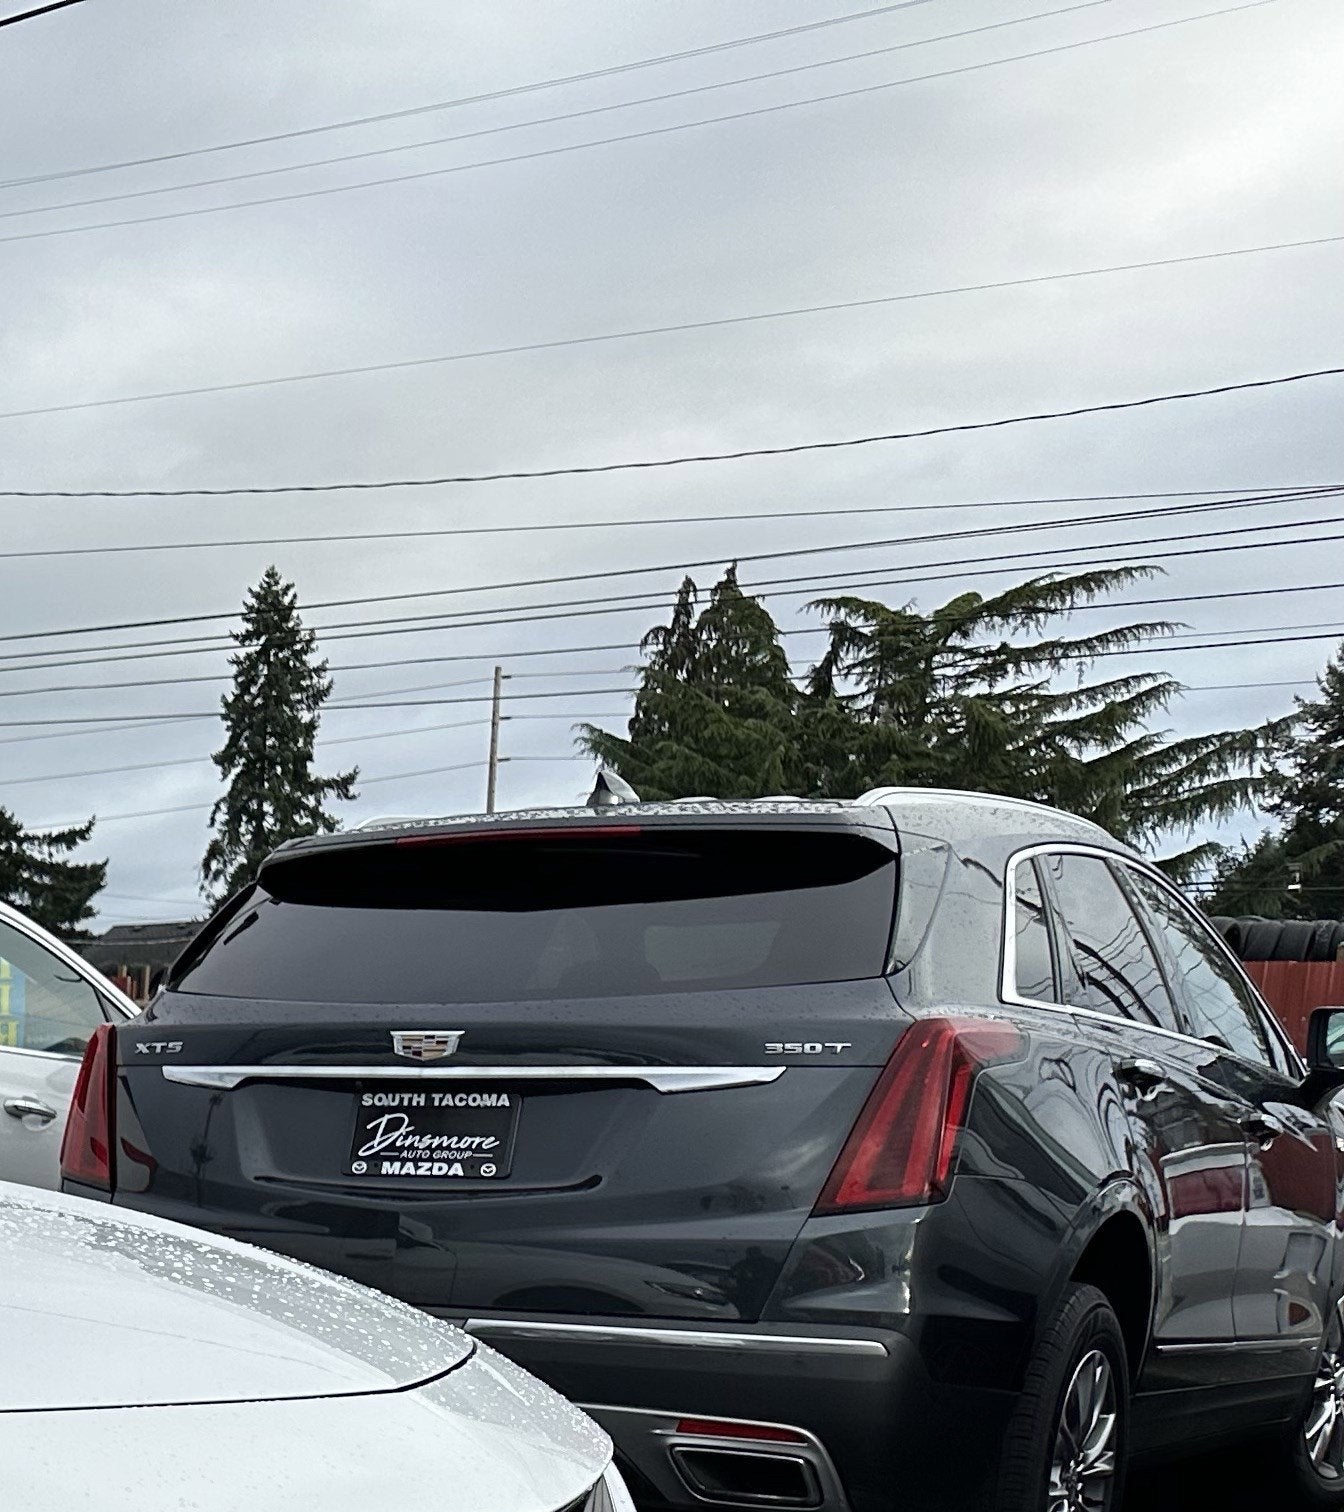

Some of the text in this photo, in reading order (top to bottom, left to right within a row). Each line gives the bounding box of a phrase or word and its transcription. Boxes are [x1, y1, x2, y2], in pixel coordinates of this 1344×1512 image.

[362, 1093, 510, 1107] SOUTH TACOMA
[358, 1112, 500, 1157] Dinsmore
[400, 1149, 473, 1160] AUTO GROUP
[380, 1161, 464, 1176] MAZDA
